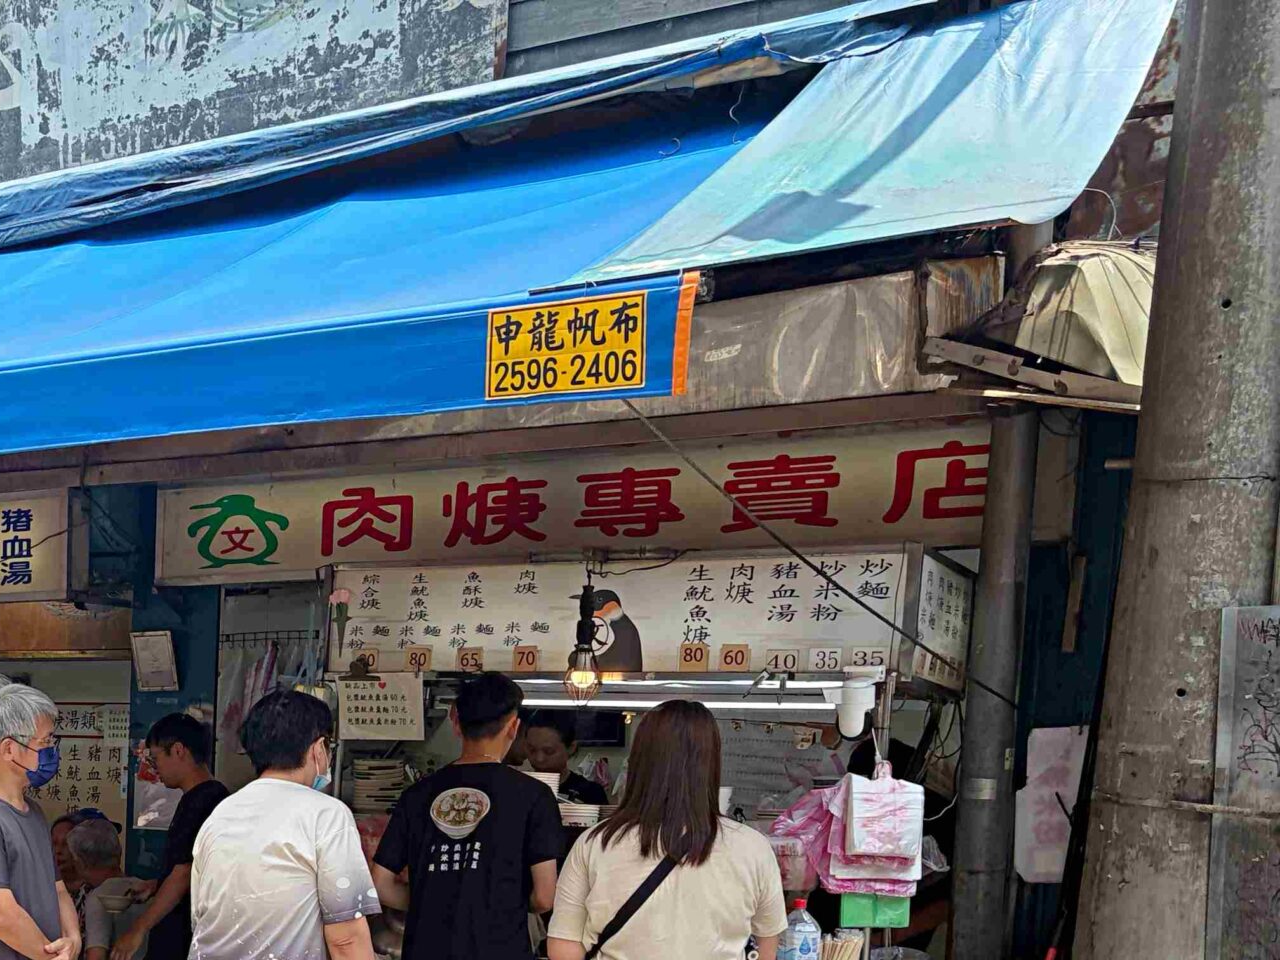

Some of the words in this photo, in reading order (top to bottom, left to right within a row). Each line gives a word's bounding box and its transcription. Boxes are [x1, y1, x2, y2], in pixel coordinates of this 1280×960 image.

[494, 301, 640, 356] 申龍帆布
[494, 350, 638, 393] 2596-2406
[220, 526, 255, 554] 文
[514, 570, 539, 595] 肉焿
[725, 563, 755, 605] 肉焿
[857, 558, 893, 599] 炒麵
[809, 560, 847, 621] 炒米粉
[408, 650, 428, 667] 80
[460, 652, 478, 668] 65
[517, 651, 535, 666] 70
[682, 648, 704, 663] 80
[723, 650, 745, 666] 60
[767, 652, 797, 670] 40
[815, 650, 839, 670] 35
[853, 649, 884, 667] 35
